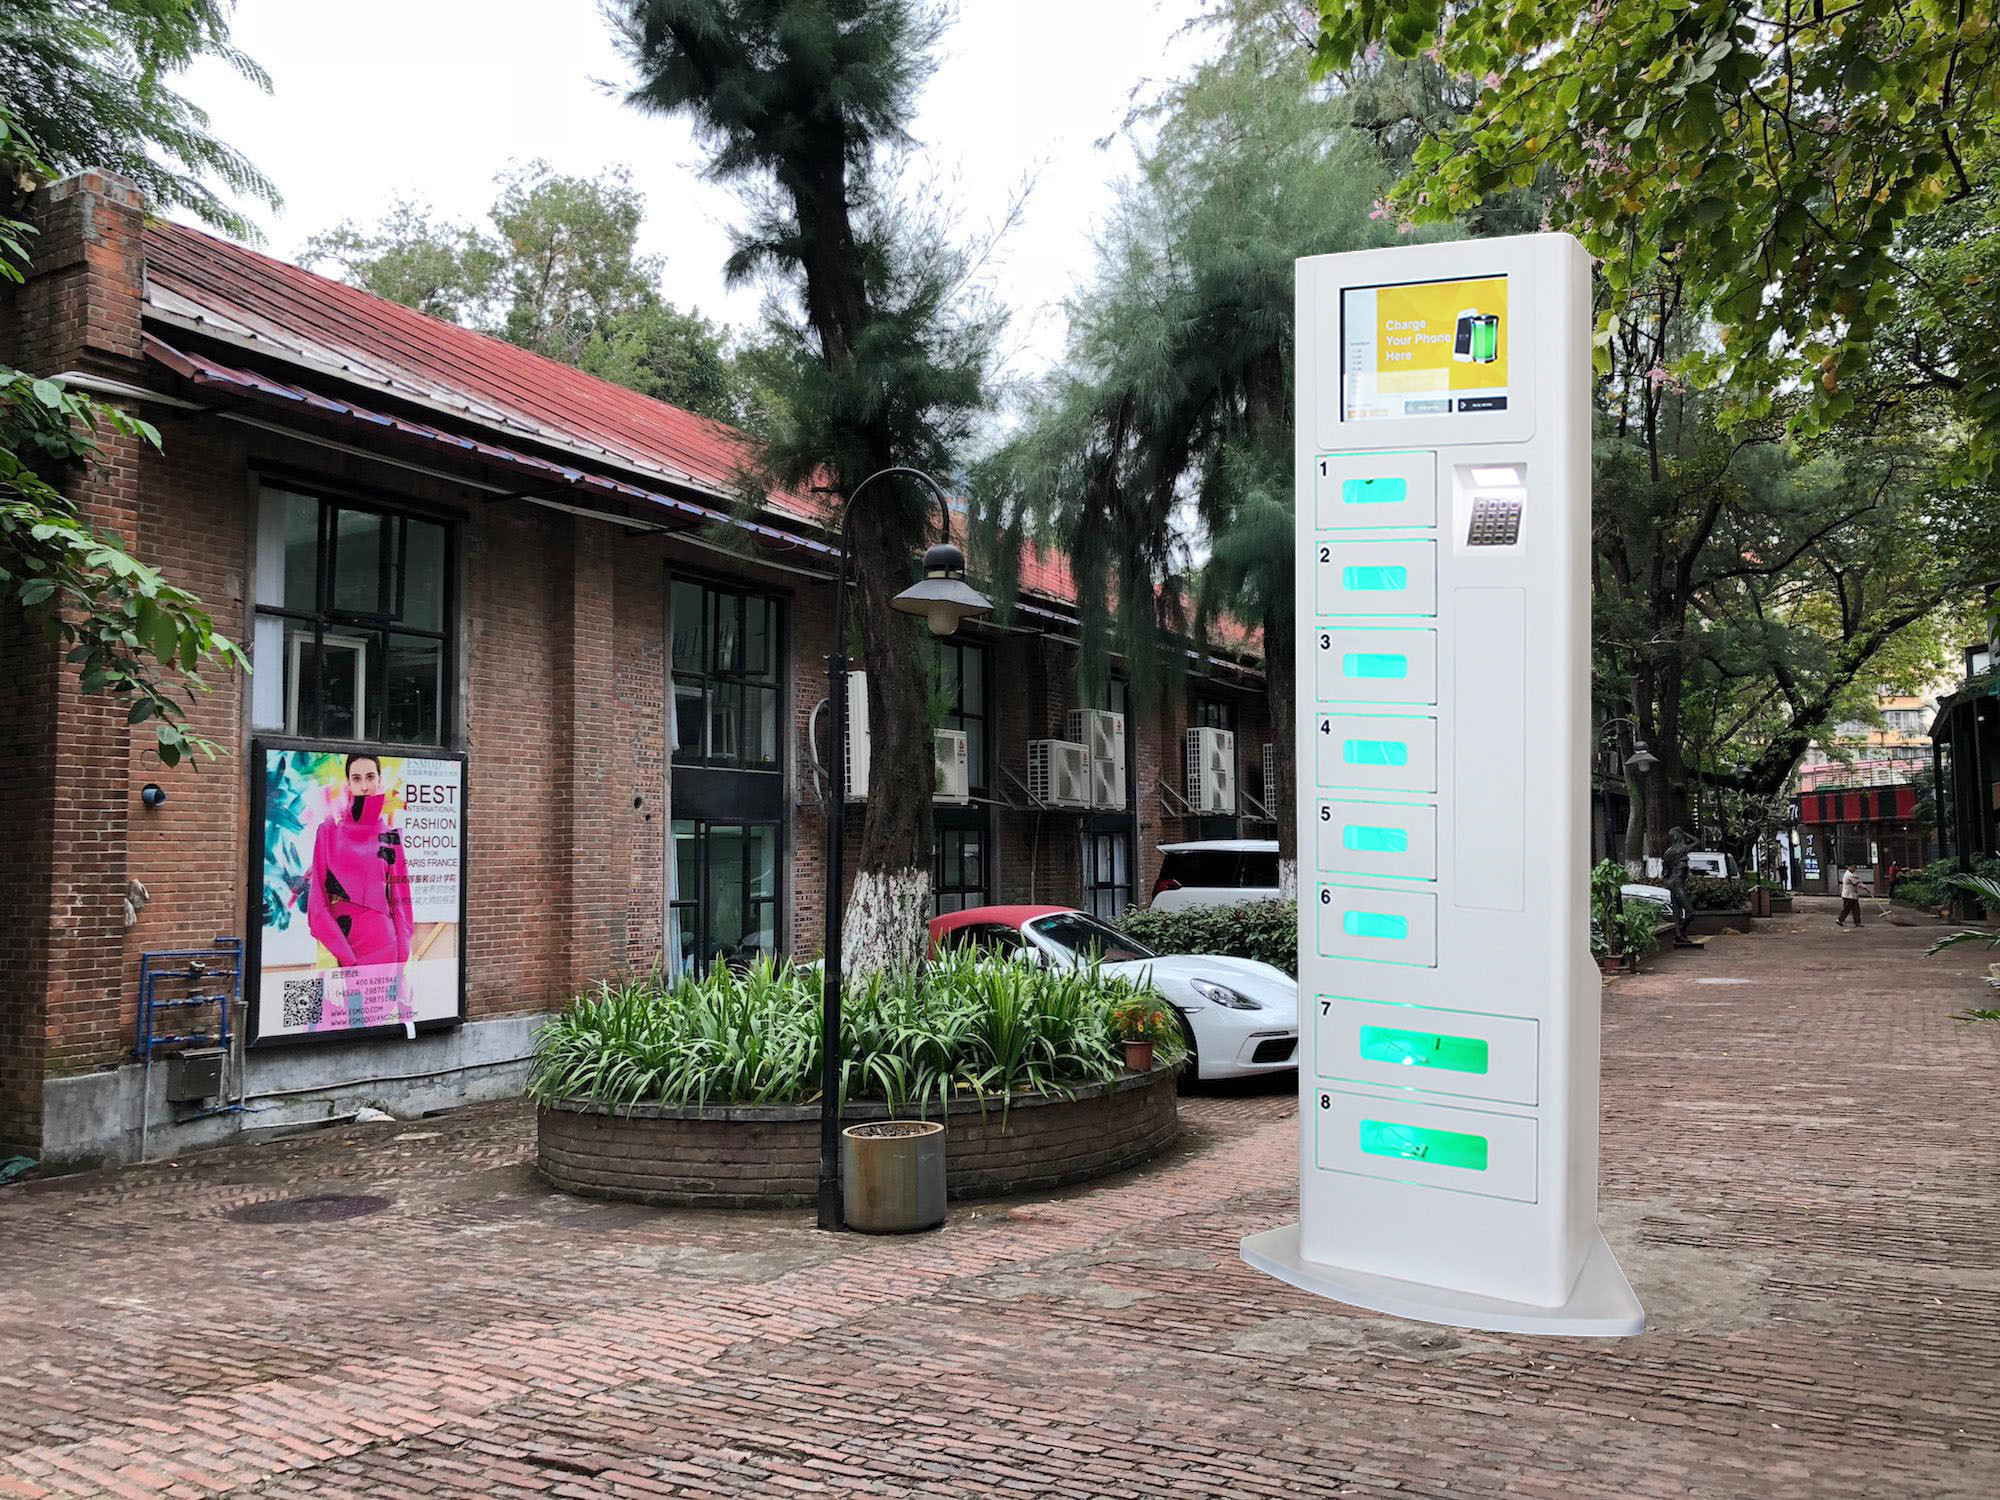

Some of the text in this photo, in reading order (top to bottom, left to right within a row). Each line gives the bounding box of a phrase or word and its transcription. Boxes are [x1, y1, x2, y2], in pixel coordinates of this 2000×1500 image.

[1386, 319, 1427, 333] Charge
[1386, 332, 1452, 347] Your Phone
[1386, 350, 1413, 361] Here
[1320, 462, 1326, 476] 1
[1320, 548, 1331, 562] 2
[1320, 635, 1331, 649] 3
[1320, 720, 1331, 734] 4
[406, 784, 457, 804] BEST
[405, 804, 456, 813] NTERNATIONAL
[1320, 807, 1331, 821] 5
[405, 818, 456, 829] FASHION
[404, 835, 457, 848] SCHOOL
[404, 858, 458, 868] PARIS FRANCE
[1320, 889, 1331, 904] 6
[356, 978, 368, 986] 400
[1320, 1001, 1331, 1015] 7
[1320, 1095, 1331, 1109] 8
